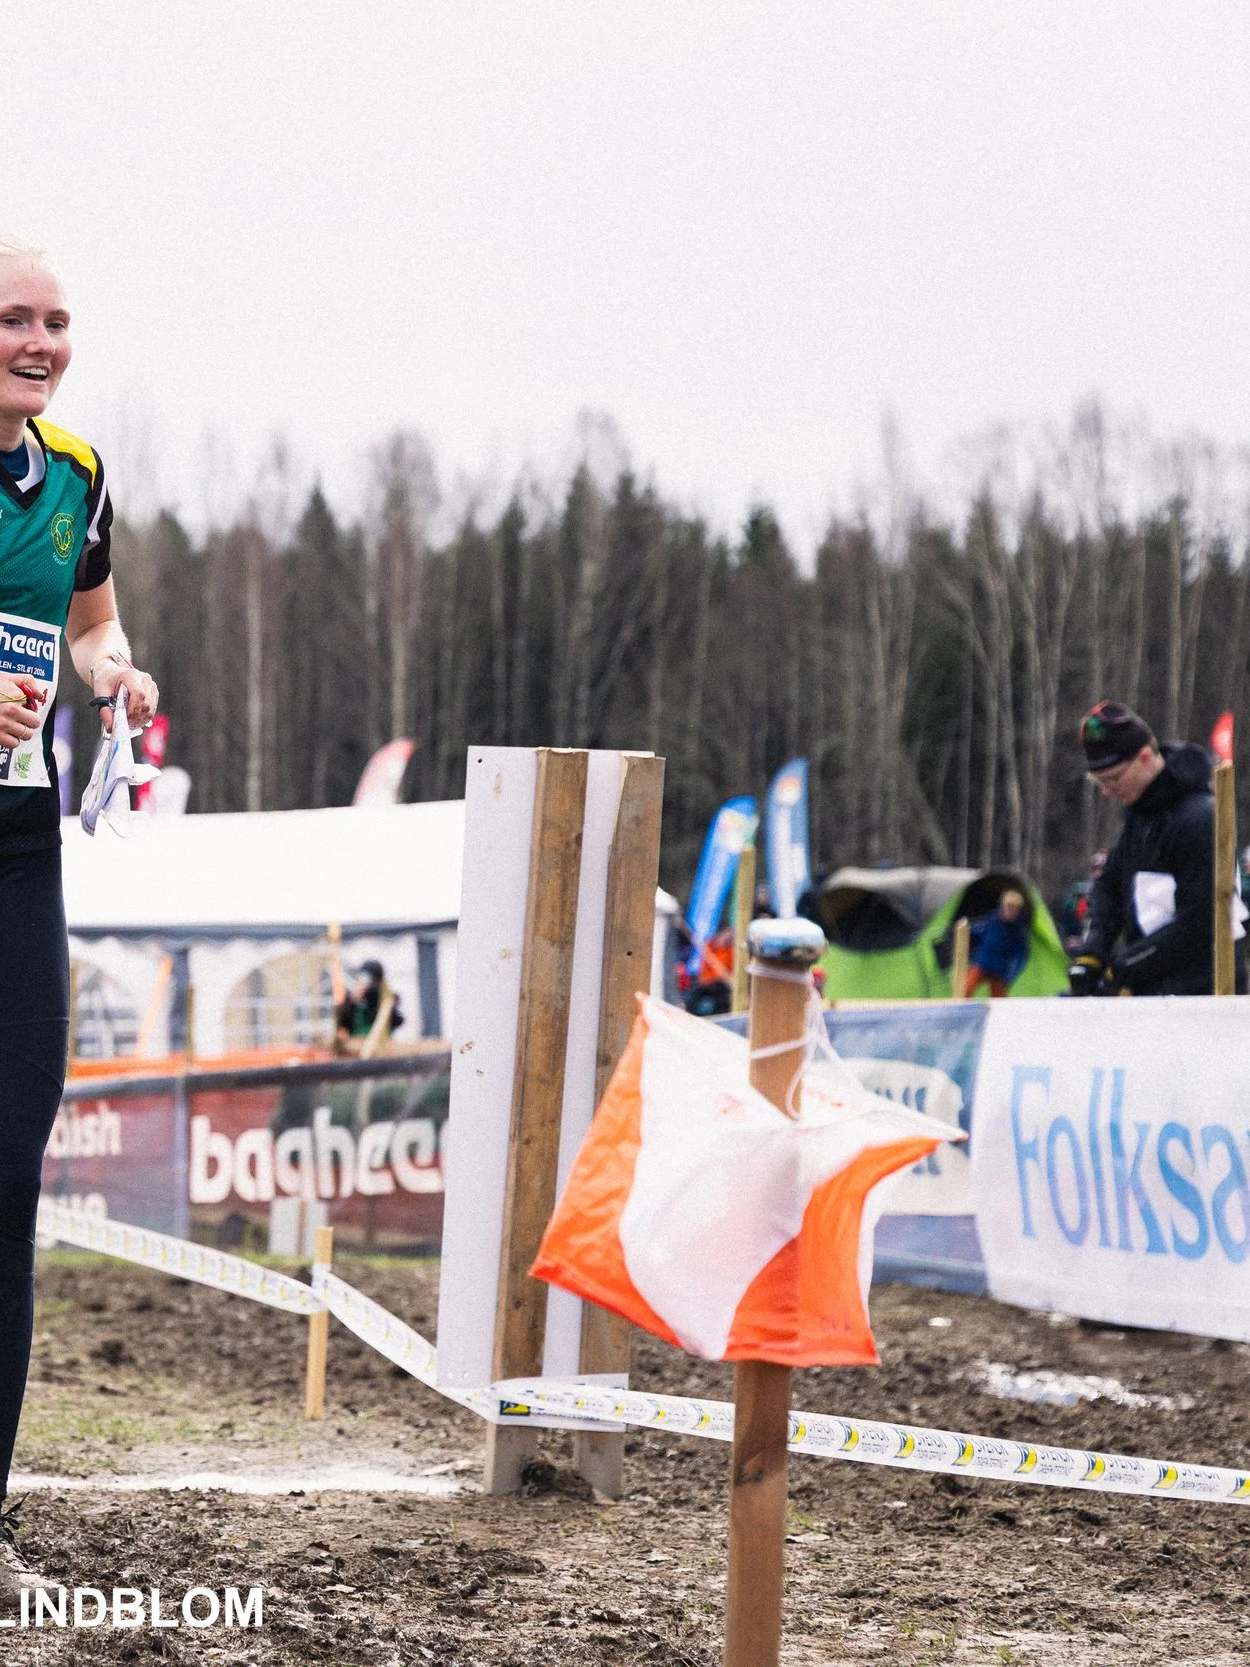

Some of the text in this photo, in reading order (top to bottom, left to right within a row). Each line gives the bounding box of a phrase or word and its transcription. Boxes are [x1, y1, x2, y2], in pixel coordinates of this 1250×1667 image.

[16, 663, 26, 673] STL
[189, 1106, 447, 1204] baghee
[1010, 1065, 1250, 1265] Folksa
